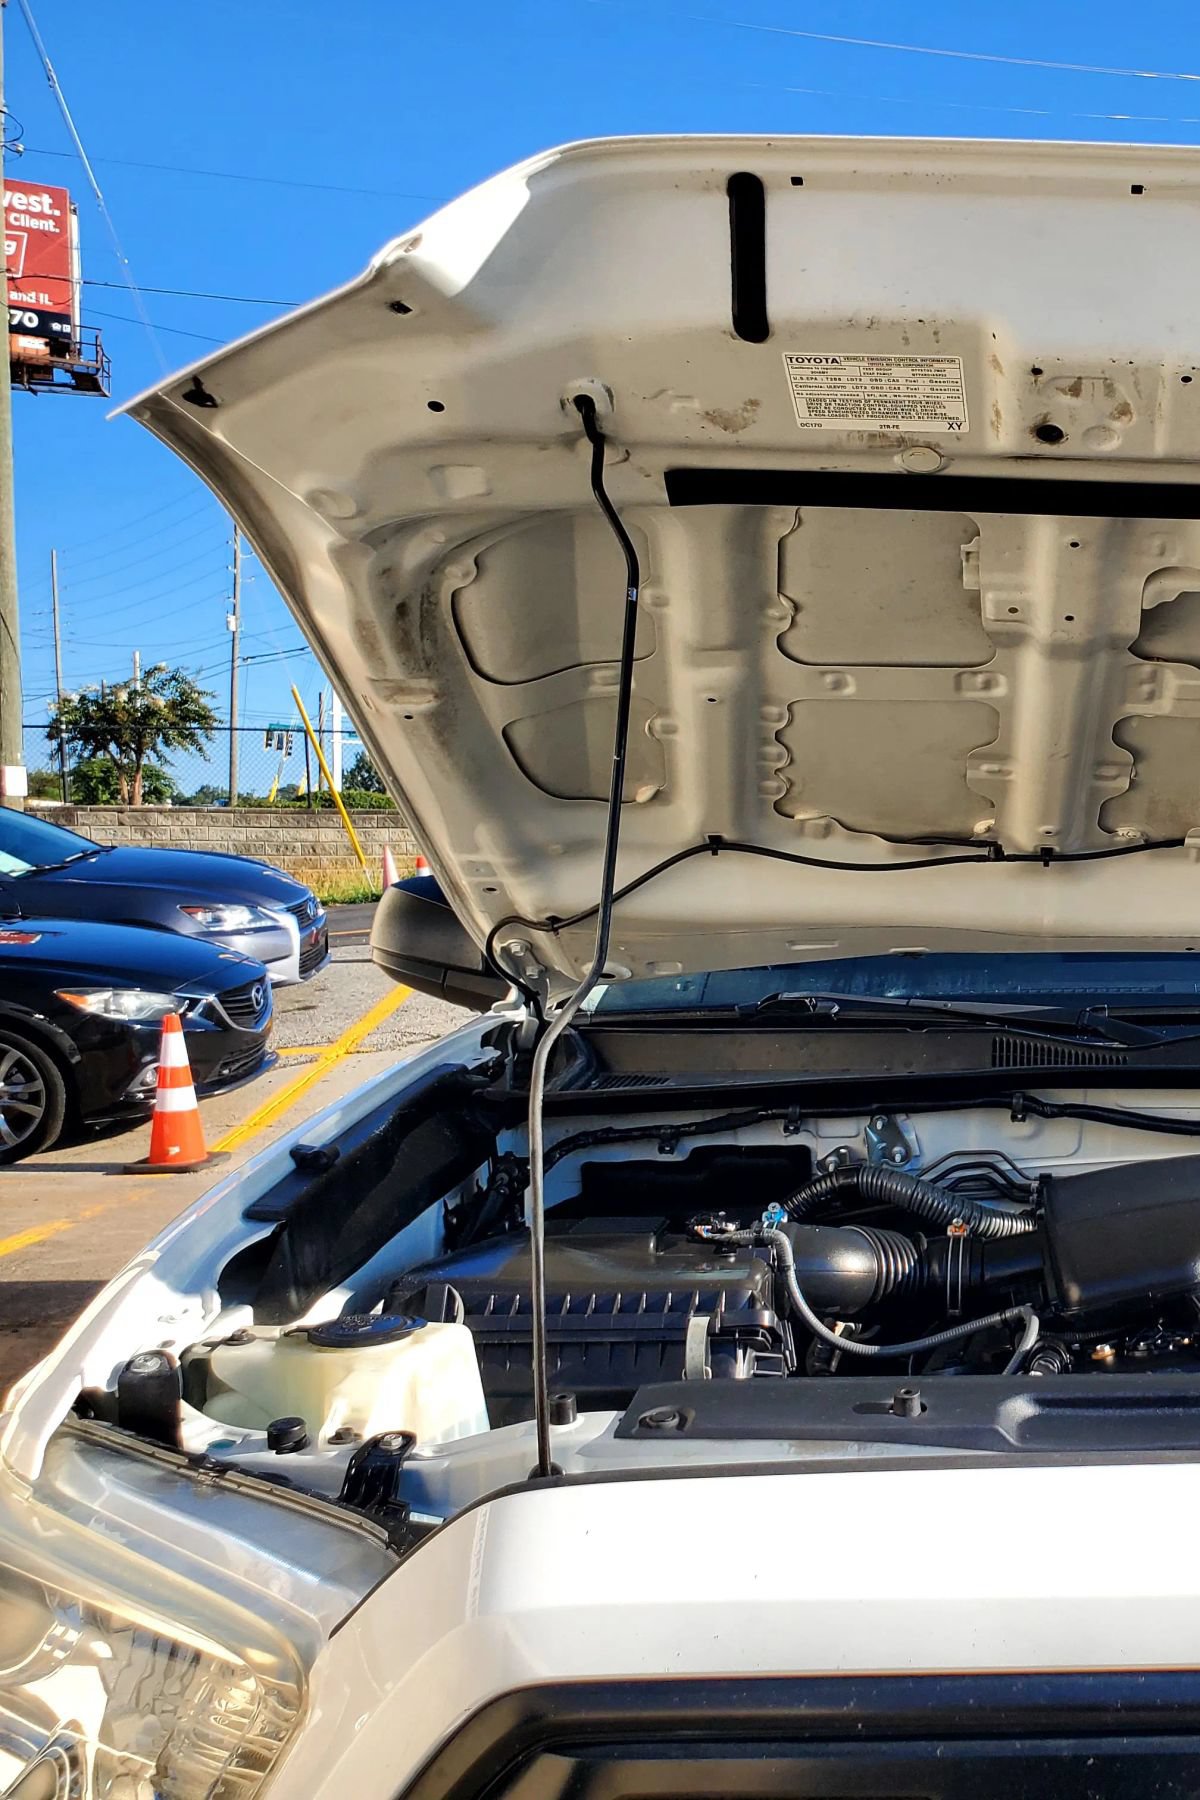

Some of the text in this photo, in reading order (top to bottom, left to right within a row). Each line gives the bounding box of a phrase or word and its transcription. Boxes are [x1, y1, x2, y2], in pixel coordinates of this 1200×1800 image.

[10, 212, 60, 233] Client.
[10, 291, 36, 304] and
[8, 309, 39, 328] 70
[948, 422, 962, 430] XY
